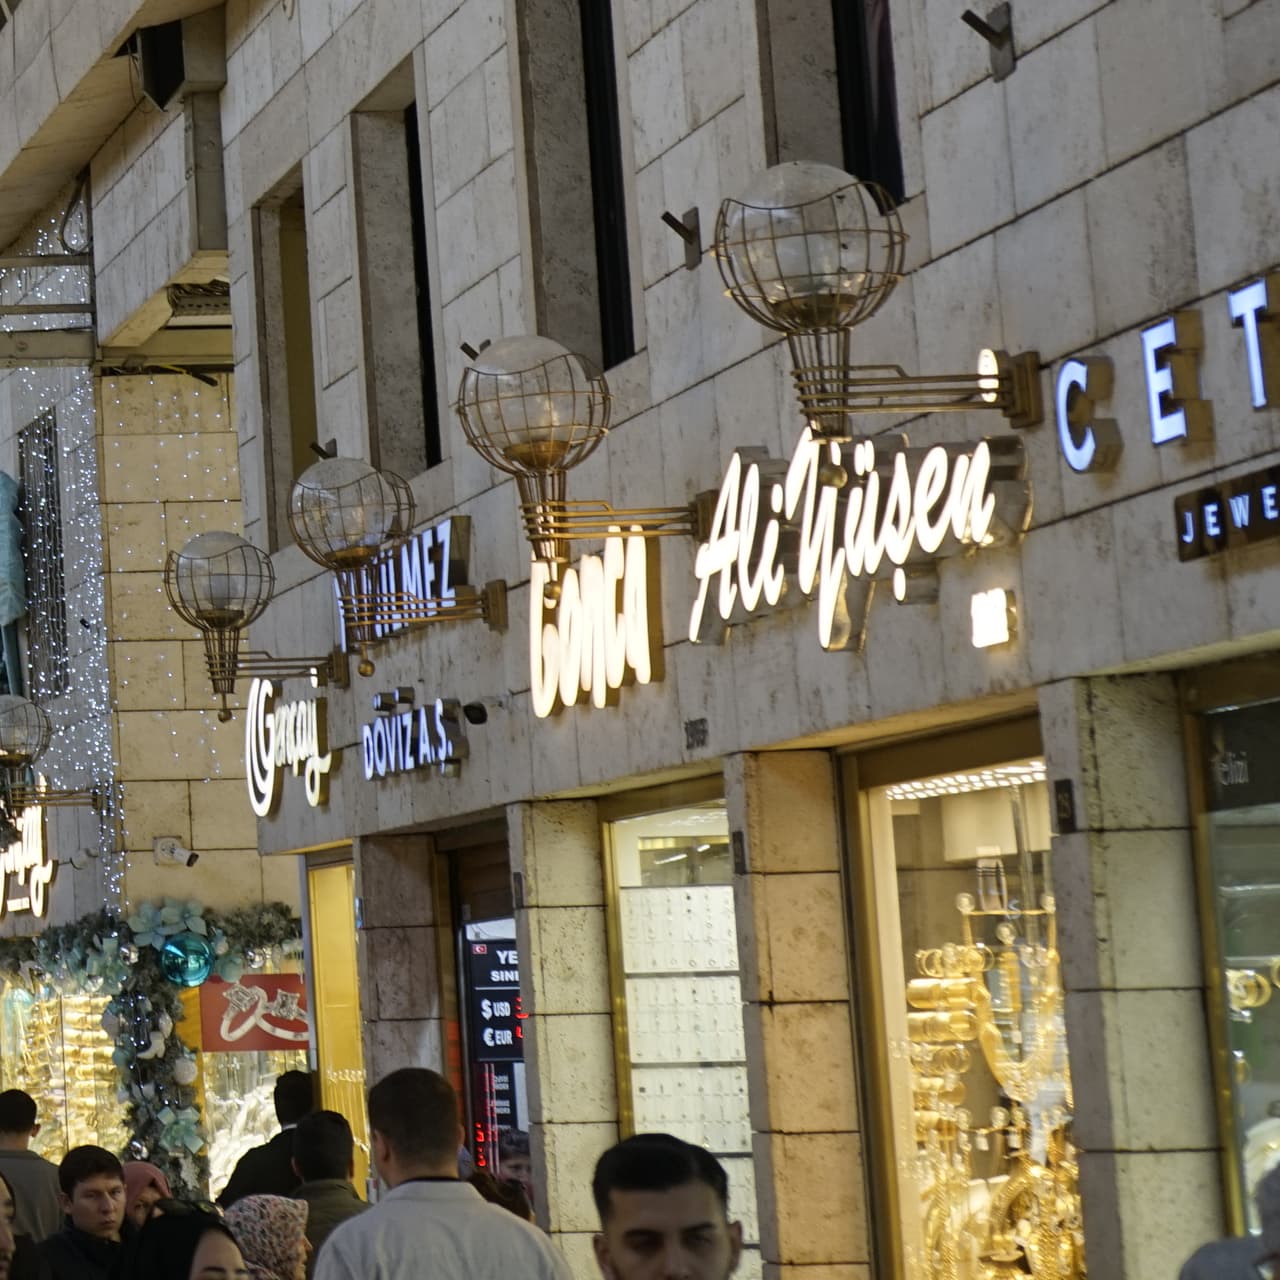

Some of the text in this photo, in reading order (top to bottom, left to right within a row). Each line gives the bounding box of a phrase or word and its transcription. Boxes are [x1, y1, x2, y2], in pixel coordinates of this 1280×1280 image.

[1056, 278, 1267, 473] CET
[690, 452, 784, 642] Ali
[1182, 485, 1279, 543] JEWE
[246, 670, 332, 817] Gençay
[363, 688, 415, 780] DÖVİZ
[493, 1002, 511, 1018] USD
[495, 1029, 513, 1046] EUR
